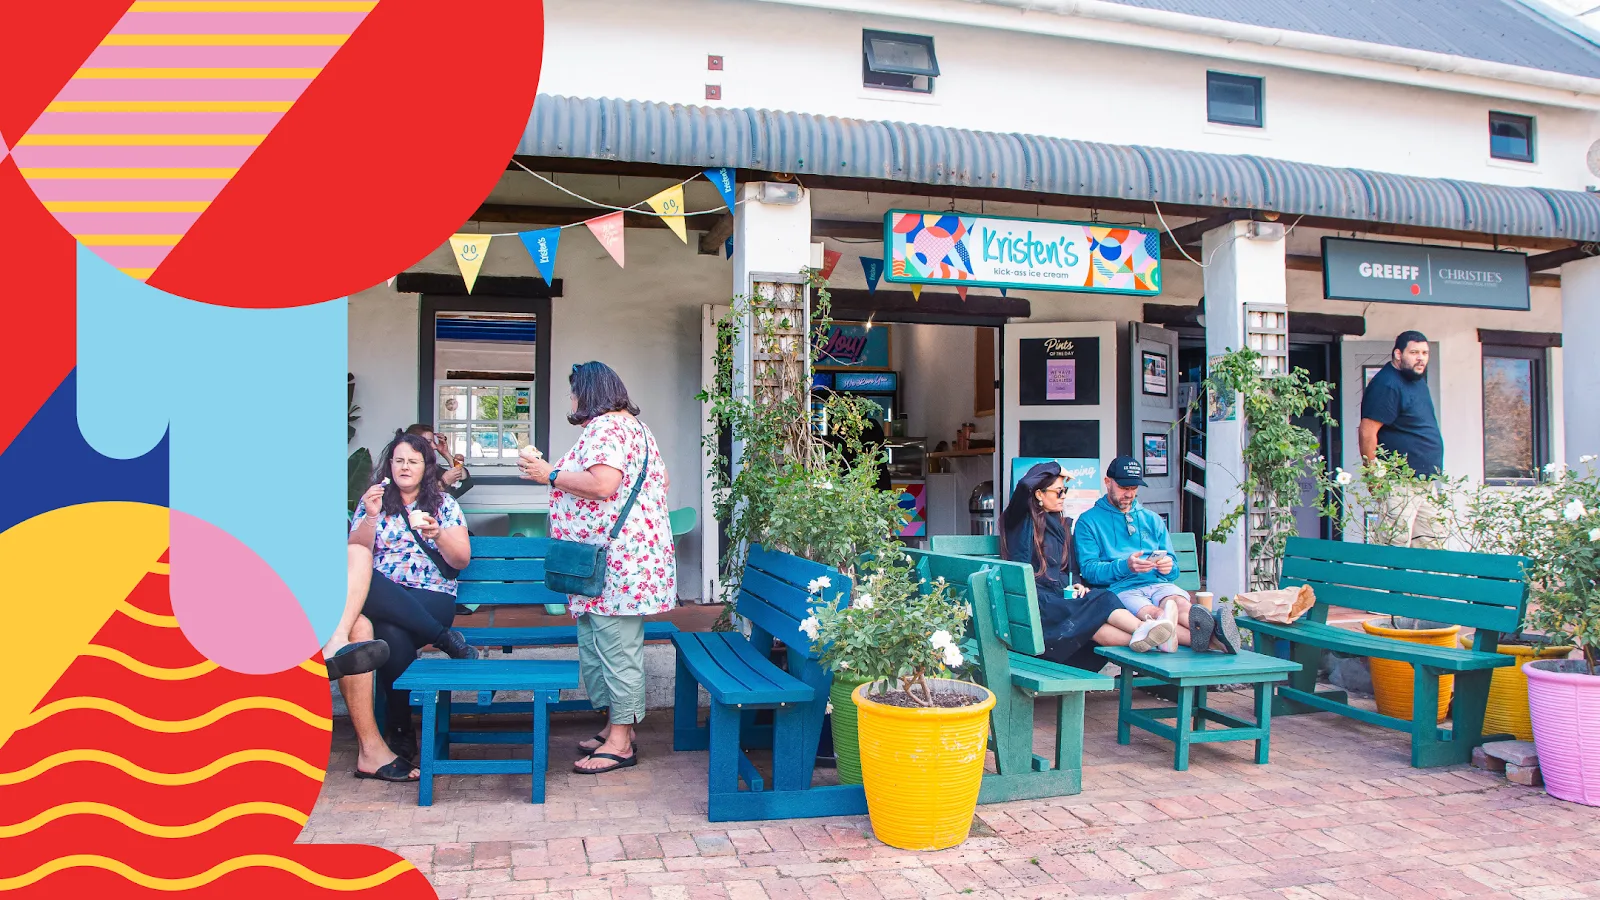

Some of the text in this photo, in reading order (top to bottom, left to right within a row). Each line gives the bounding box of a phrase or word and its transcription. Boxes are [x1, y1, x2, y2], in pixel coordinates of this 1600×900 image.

[720, 168, 732, 193] Kristen's
[539, 237, 549, 263] Kristen's
[982, 227, 1079, 268] Kristen's
[993, 267, 1069, 279] kick-ass ice cream
[1359, 262, 1419, 280] GREEFF
[1438, 268, 1503, 283] CHRISTIE'S
[1044, 338, 1074, 352] Pints
